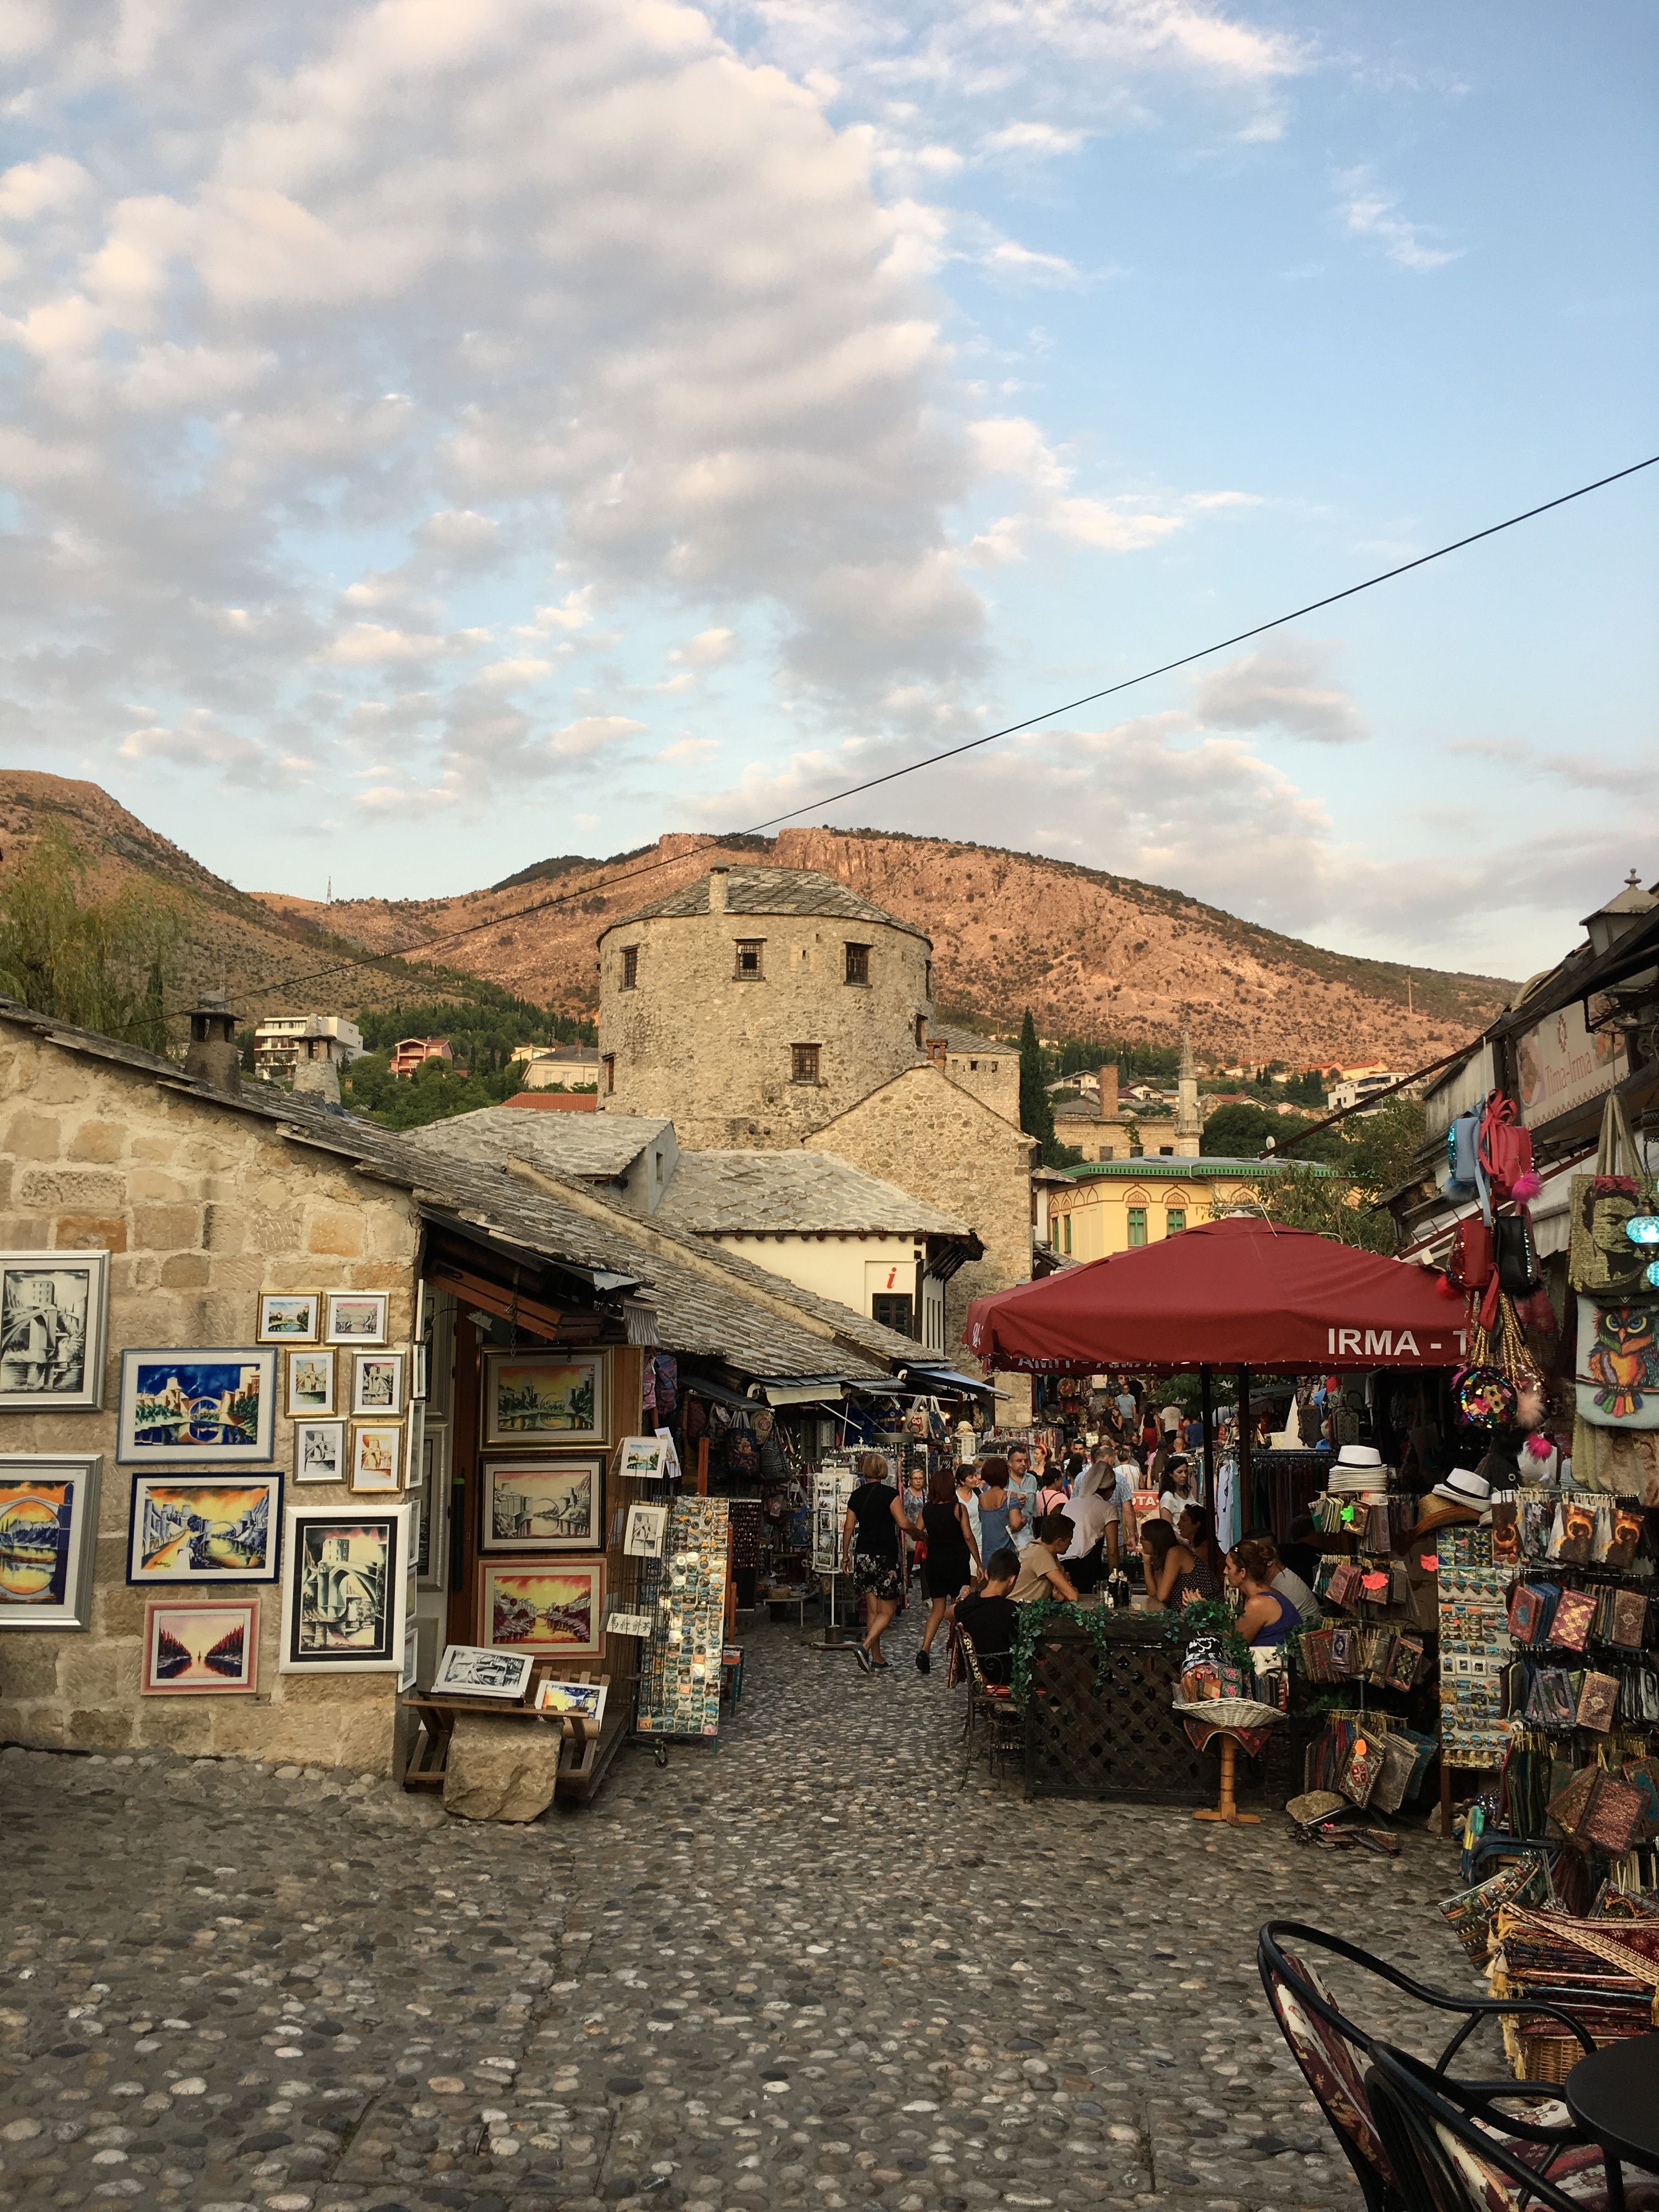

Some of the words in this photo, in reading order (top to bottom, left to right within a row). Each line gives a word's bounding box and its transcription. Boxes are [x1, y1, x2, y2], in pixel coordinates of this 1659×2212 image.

[887, 1267, 897, 1289] i
[1328, 1328, 1420, 1356] IRMA
[1452, 1329, 1469, 1356] T
